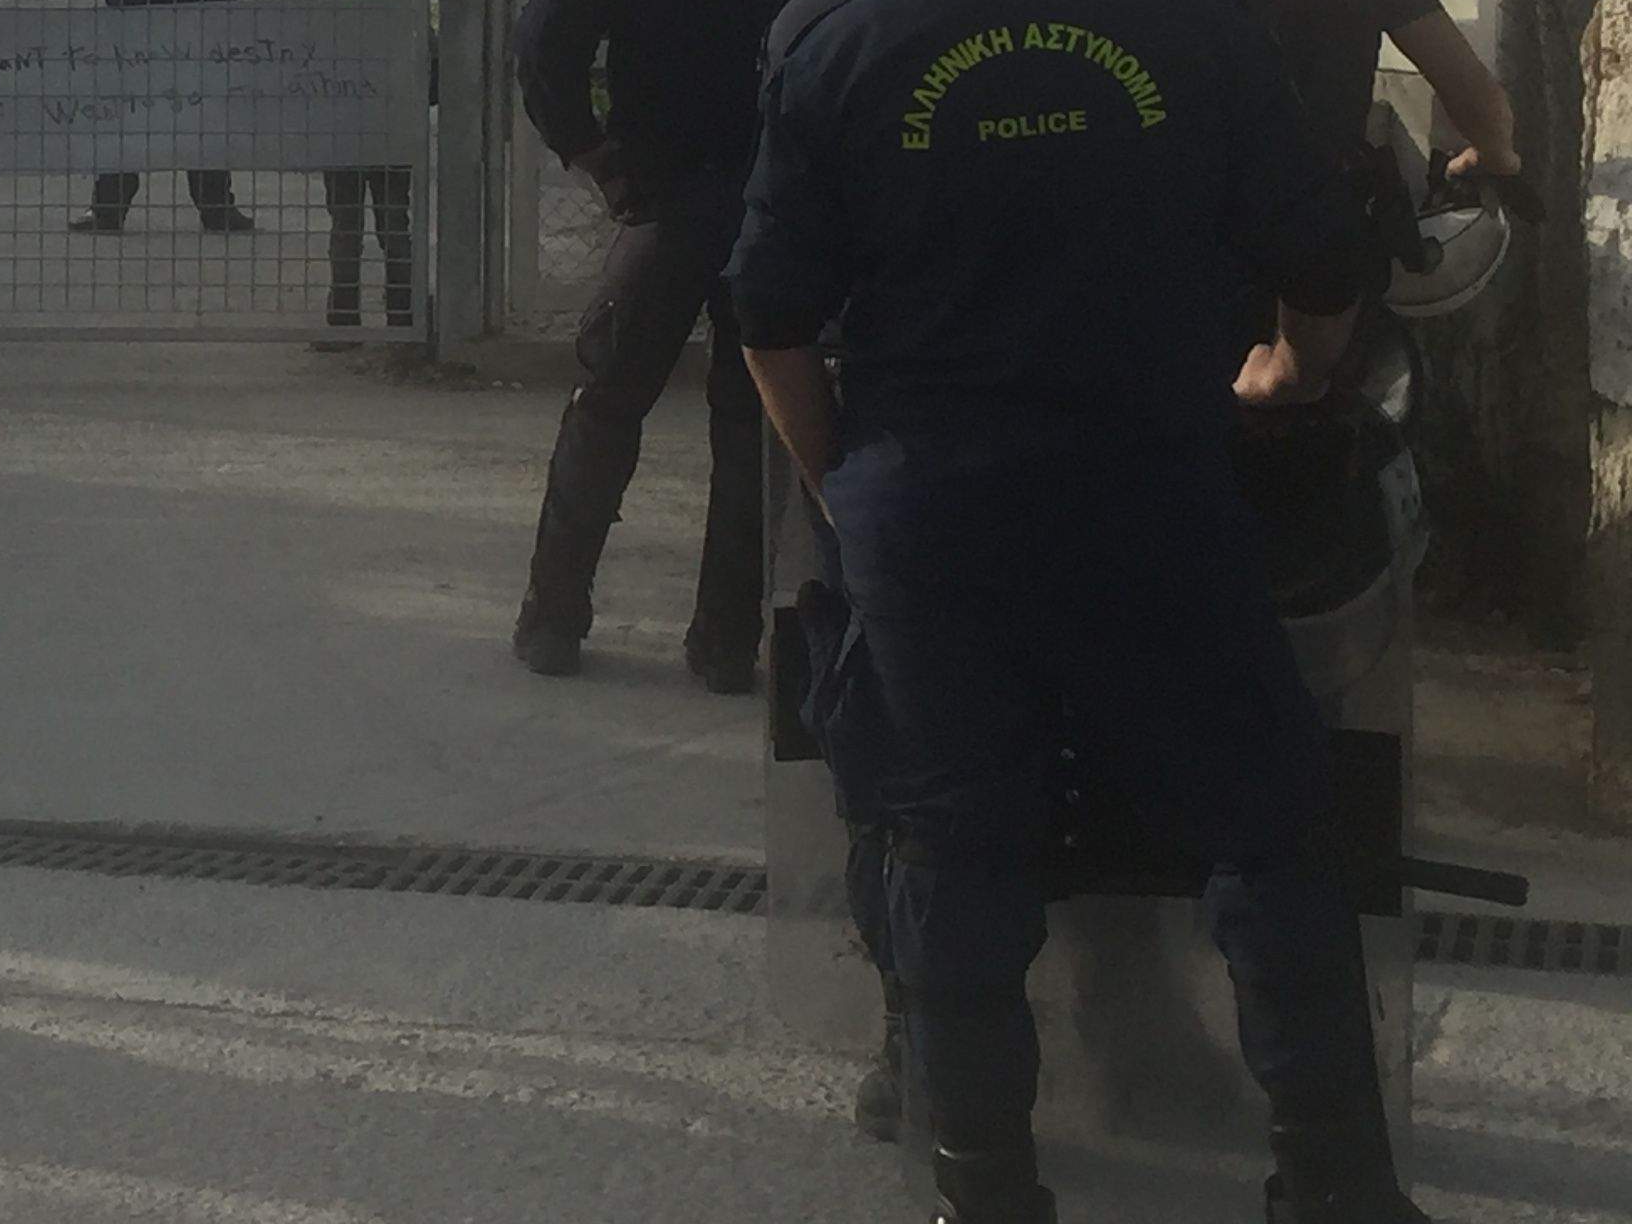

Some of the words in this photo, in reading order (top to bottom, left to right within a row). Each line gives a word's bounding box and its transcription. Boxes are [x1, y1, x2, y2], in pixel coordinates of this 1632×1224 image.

[901, 26, 1014, 151] ΕΛΛΗΝΙΚΗ
[1023, 22, 1168, 130] ΑΣΤΥΝΟΜΙΑ
[978, 109, 1088, 142] POLICE
